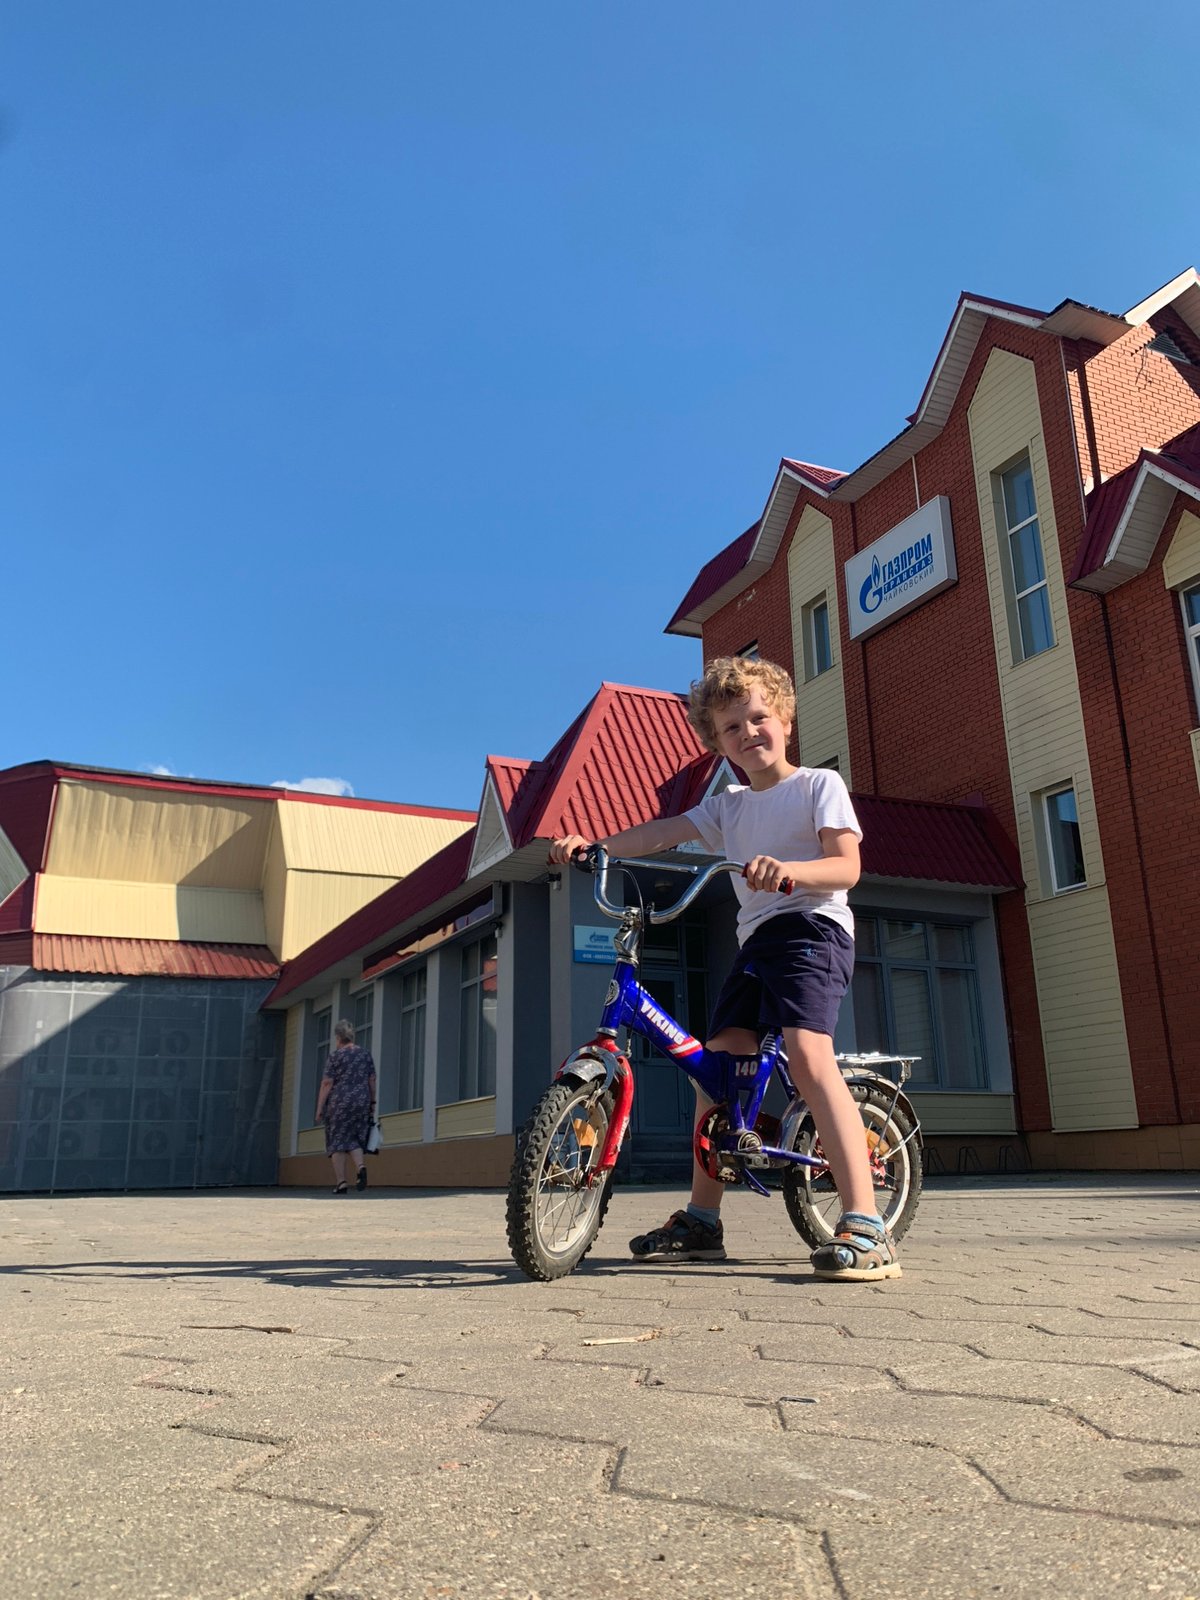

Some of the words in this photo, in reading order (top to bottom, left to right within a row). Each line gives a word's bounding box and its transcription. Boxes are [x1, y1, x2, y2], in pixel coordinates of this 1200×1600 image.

[882, 533, 933, 583] ГАЗПРОМ
[884, 553, 933, 593] ТРАНСГАЗ
[884, 565, 935, 602] ЧАЙКОВСКИЙ
[640, 999, 686, 1046] VIKING
[735, 1061, 758, 1076] 140
